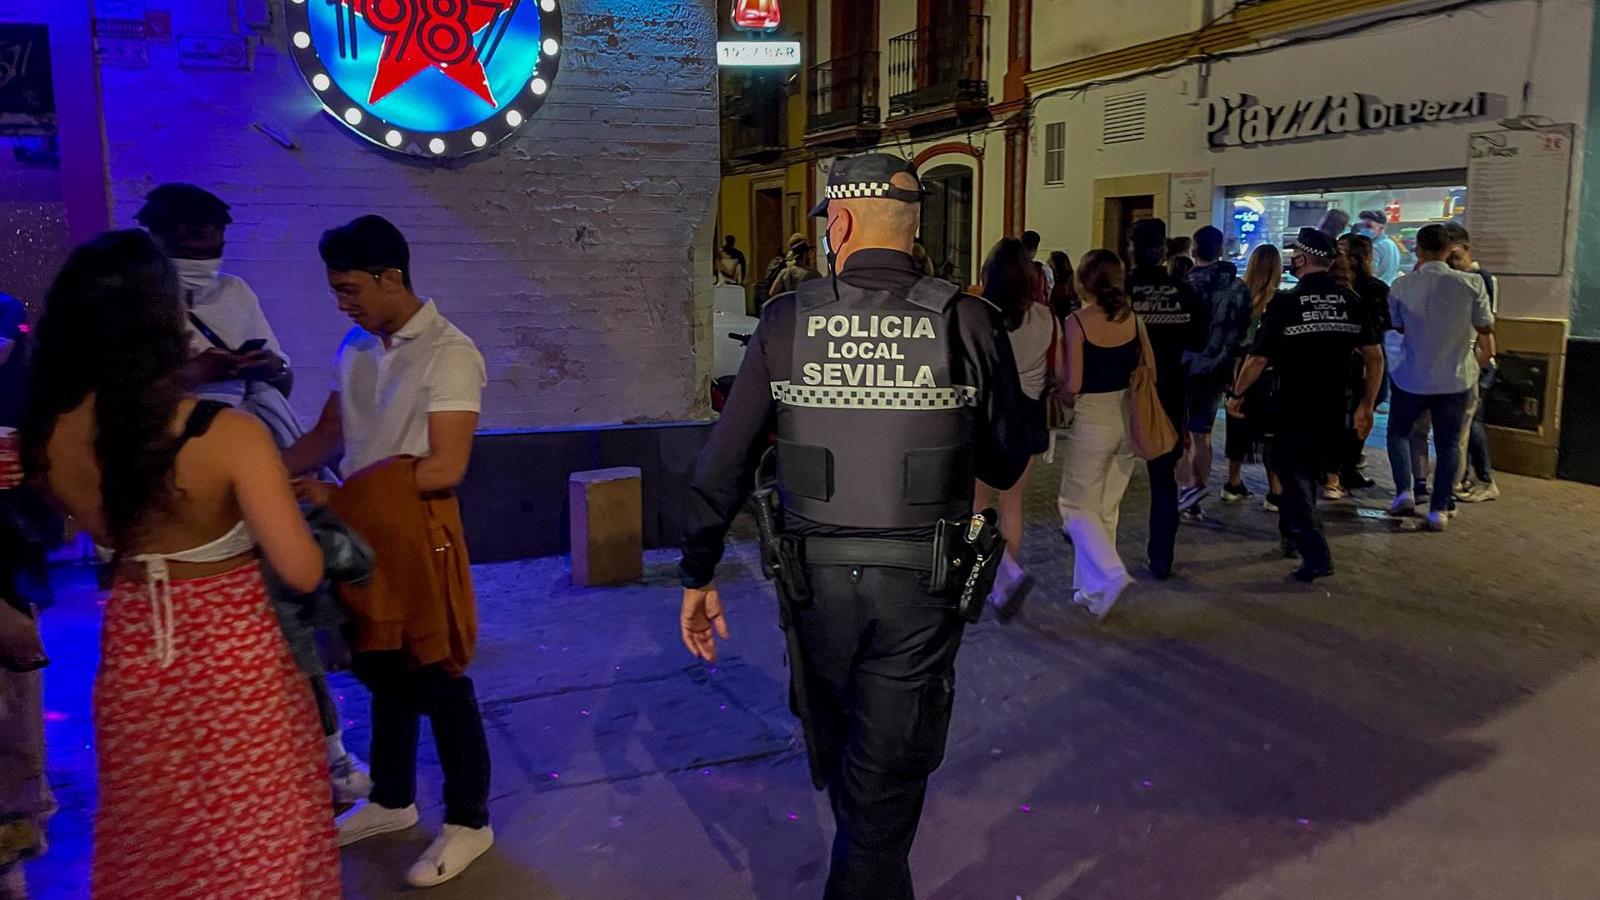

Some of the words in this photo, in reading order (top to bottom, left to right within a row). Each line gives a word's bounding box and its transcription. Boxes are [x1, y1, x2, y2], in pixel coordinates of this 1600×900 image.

[1204, 92, 1362, 147] Piazza
[807, 315, 936, 339] POLICIA
[1302, 310, 1348, 322] SEVILLA
[827, 341, 905, 360] LOCAL
[802, 363, 937, 388] SEVILLA
